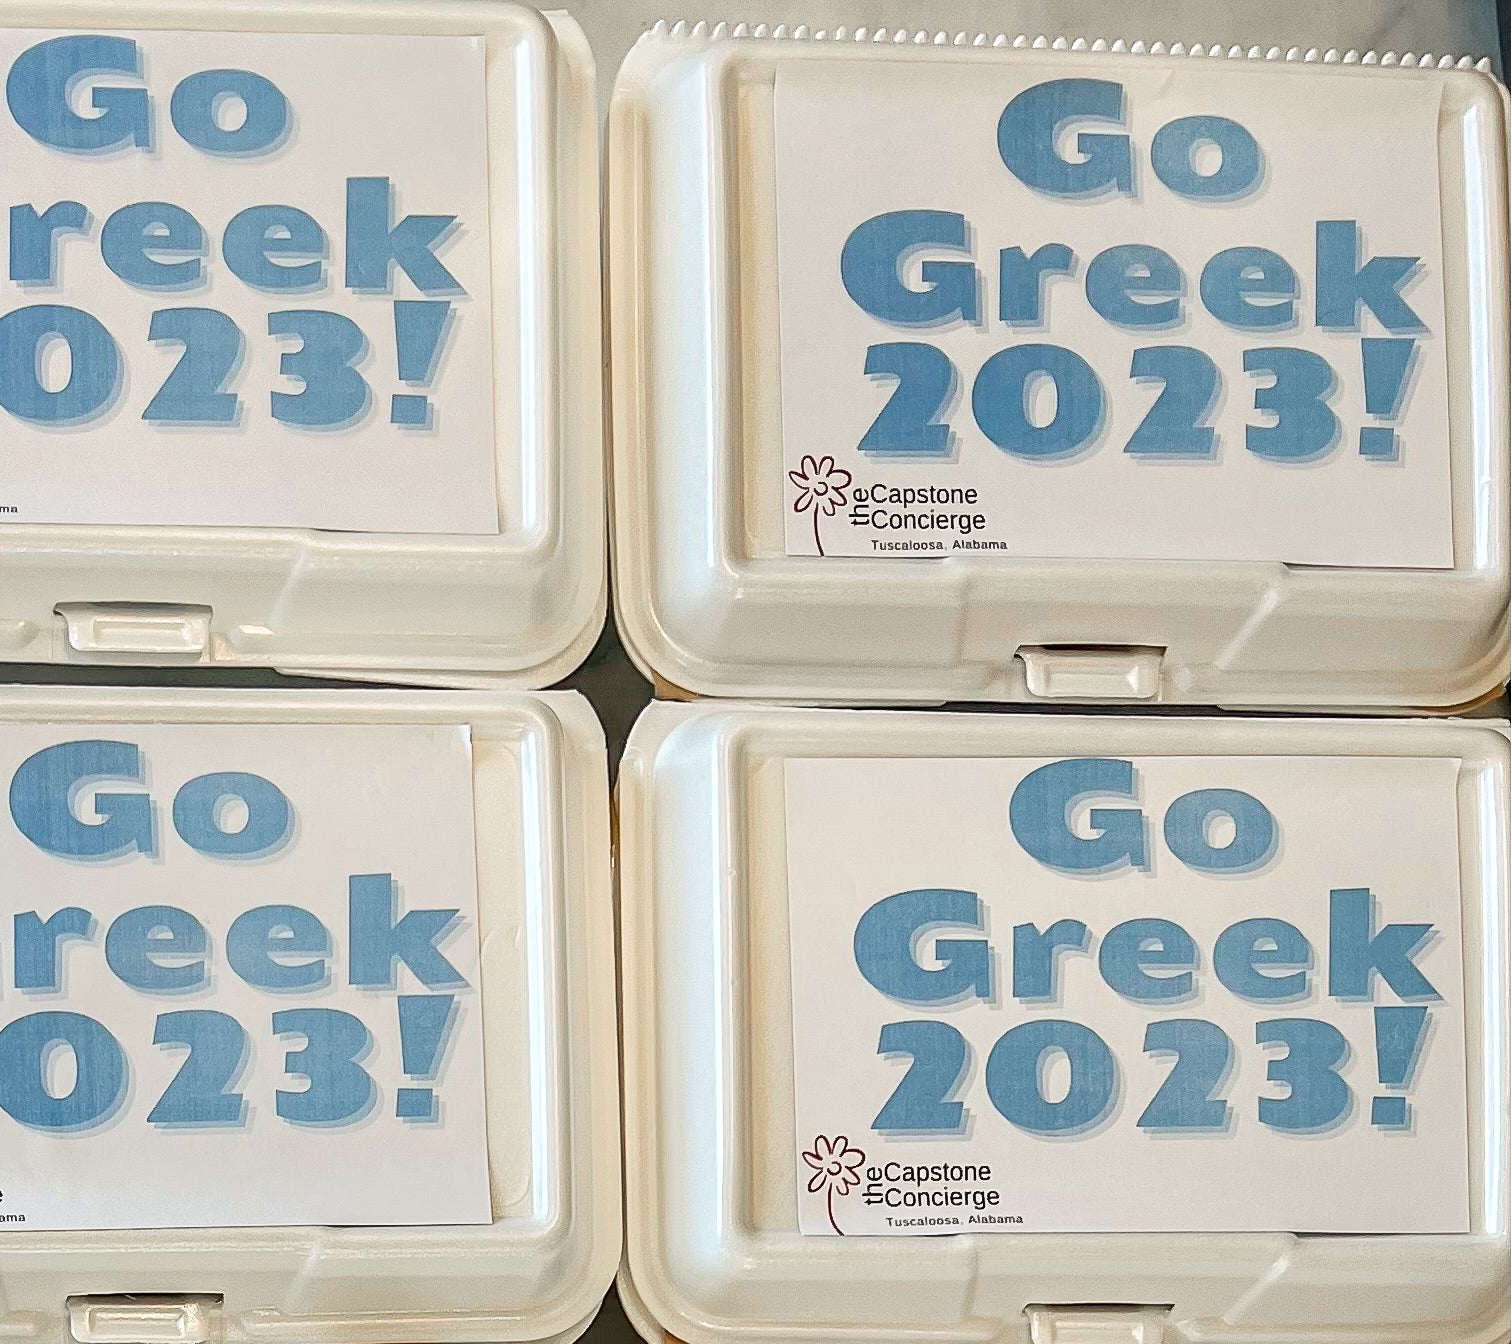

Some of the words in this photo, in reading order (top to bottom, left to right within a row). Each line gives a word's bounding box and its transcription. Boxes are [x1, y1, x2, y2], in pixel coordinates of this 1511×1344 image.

[6, 35, 293, 158] Go
[997, 78, 1265, 202] Go
[840, 210, 1431, 335] Greek
[857, 338, 1420, 464] 2023!
[847, 487, 871, 527] the
[870, 483, 978, 509] Capstone
[870, 508, 986, 535] Concierge
[951, 539, 1009, 550] Alabama
[9, 740, 295, 862] Go
[1009, 757, 1279, 875] Go
[853, 888, 1445, 1007] Greek
[870, 1006, 1433, 1137] 2023!
[861, 1166, 884, 1206] the
[884, 1161, 992, 1188] Capstone
[884, 1185, 1001, 1211] Concierge
[968, 1214, 1024, 1224] Alabama
